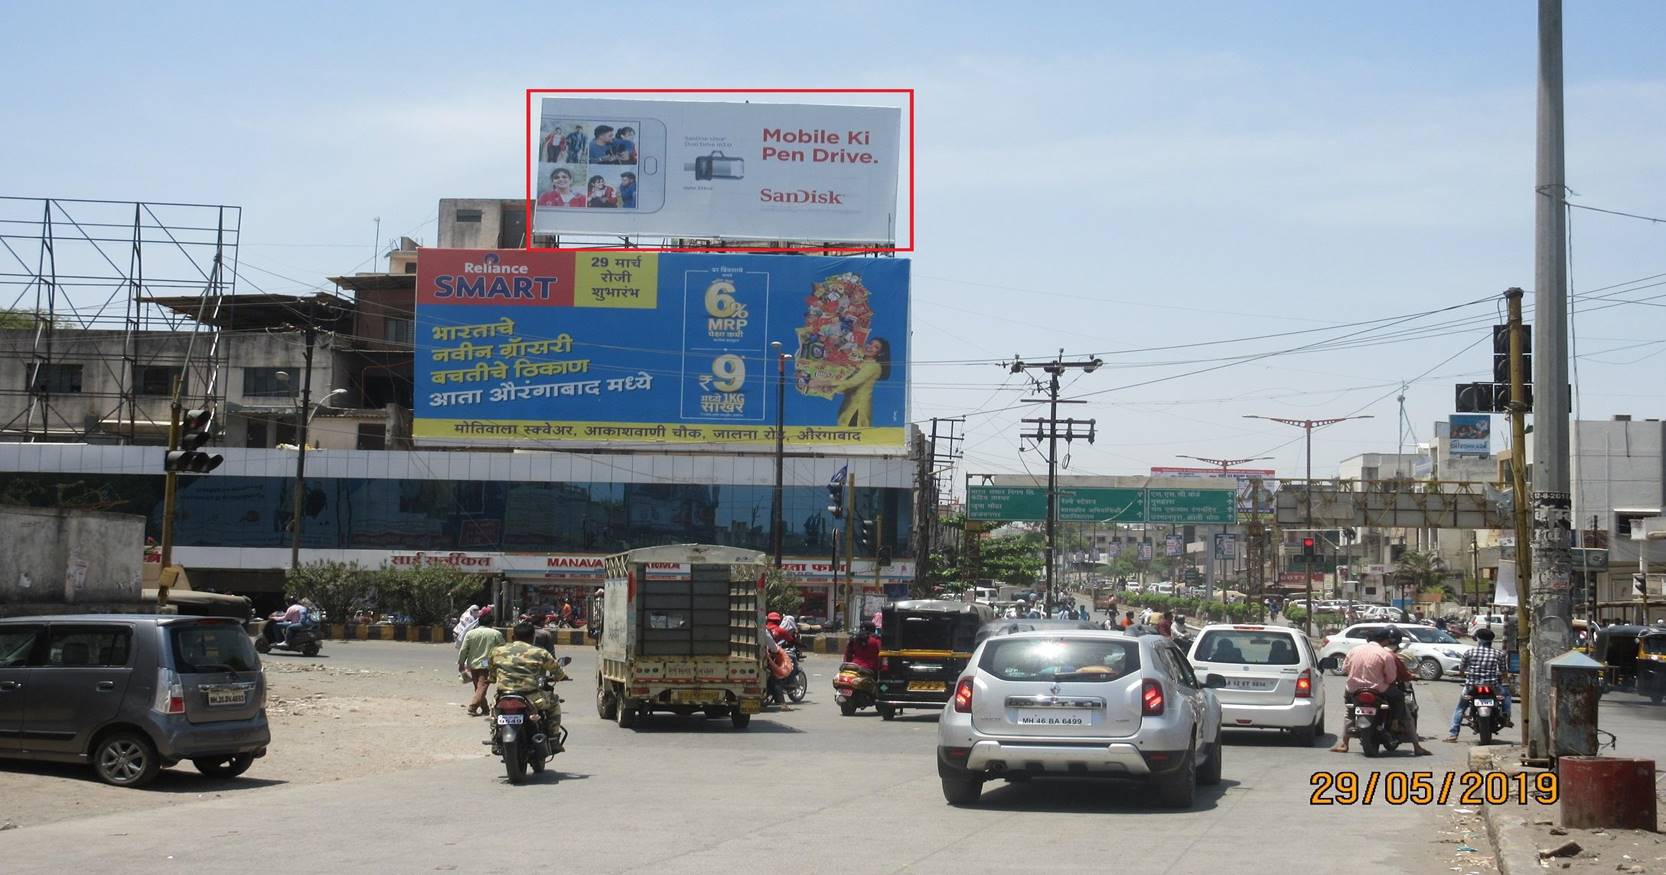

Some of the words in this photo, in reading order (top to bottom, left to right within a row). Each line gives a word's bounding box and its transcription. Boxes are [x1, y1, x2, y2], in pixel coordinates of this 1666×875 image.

[763, 128, 840, 144] Mobile
[848, 131, 870, 145] Ki
[762, 147, 804, 162] Pen
[812, 148, 879, 164] Drive.
[760, 188, 845, 205] SanDisk
[464, 262, 529, 274] Reliance
[591, 257, 609, 267] 29
[615, 255, 642, 268] मार्च
[600, 270, 632, 283] रोजी
[434, 275, 557, 299] SMART
[591, 285, 640, 301] शुभारंभ
[704, 282, 748, 318] 6%
[431, 317, 516, 341] भारताचे
[708, 318, 748, 331] MRP
[431, 341, 493, 362] नवीन
[431, 361, 509, 385] बचतीचे
[514, 358, 590, 379] ठिकाण
[429, 389, 483, 407] आता
[489, 379, 601, 401] औरंगाबाद
[607, 371, 654, 392] मध्ये
[701, 402, 744, 413] साखर
[584, 425, 666, 438] आकाशवाणी
[713, 429, 758, 440] जालना
[797, 427, 861, 441] औरंगाबाद
